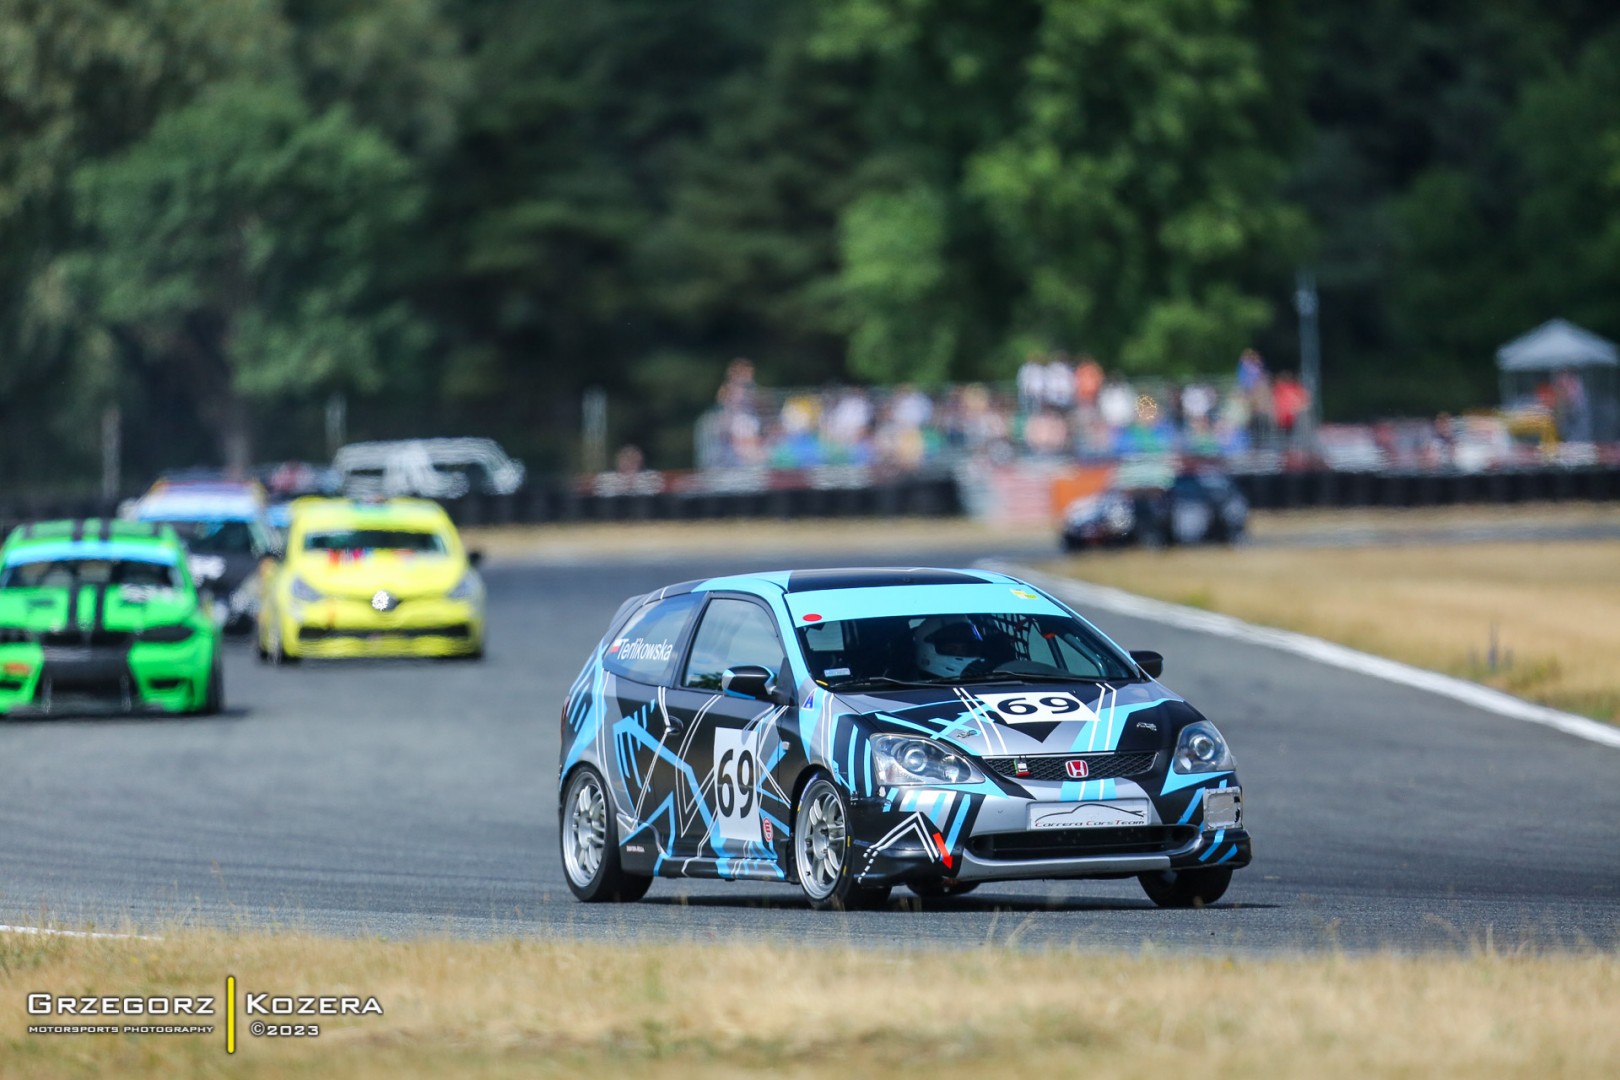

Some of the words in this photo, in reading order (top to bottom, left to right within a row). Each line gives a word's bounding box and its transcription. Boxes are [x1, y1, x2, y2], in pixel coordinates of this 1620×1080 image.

[997, 696, 1080, 715] 69
[717, 748, 754, 819] 69
[1035, 820, 1083, 828] Carrera
